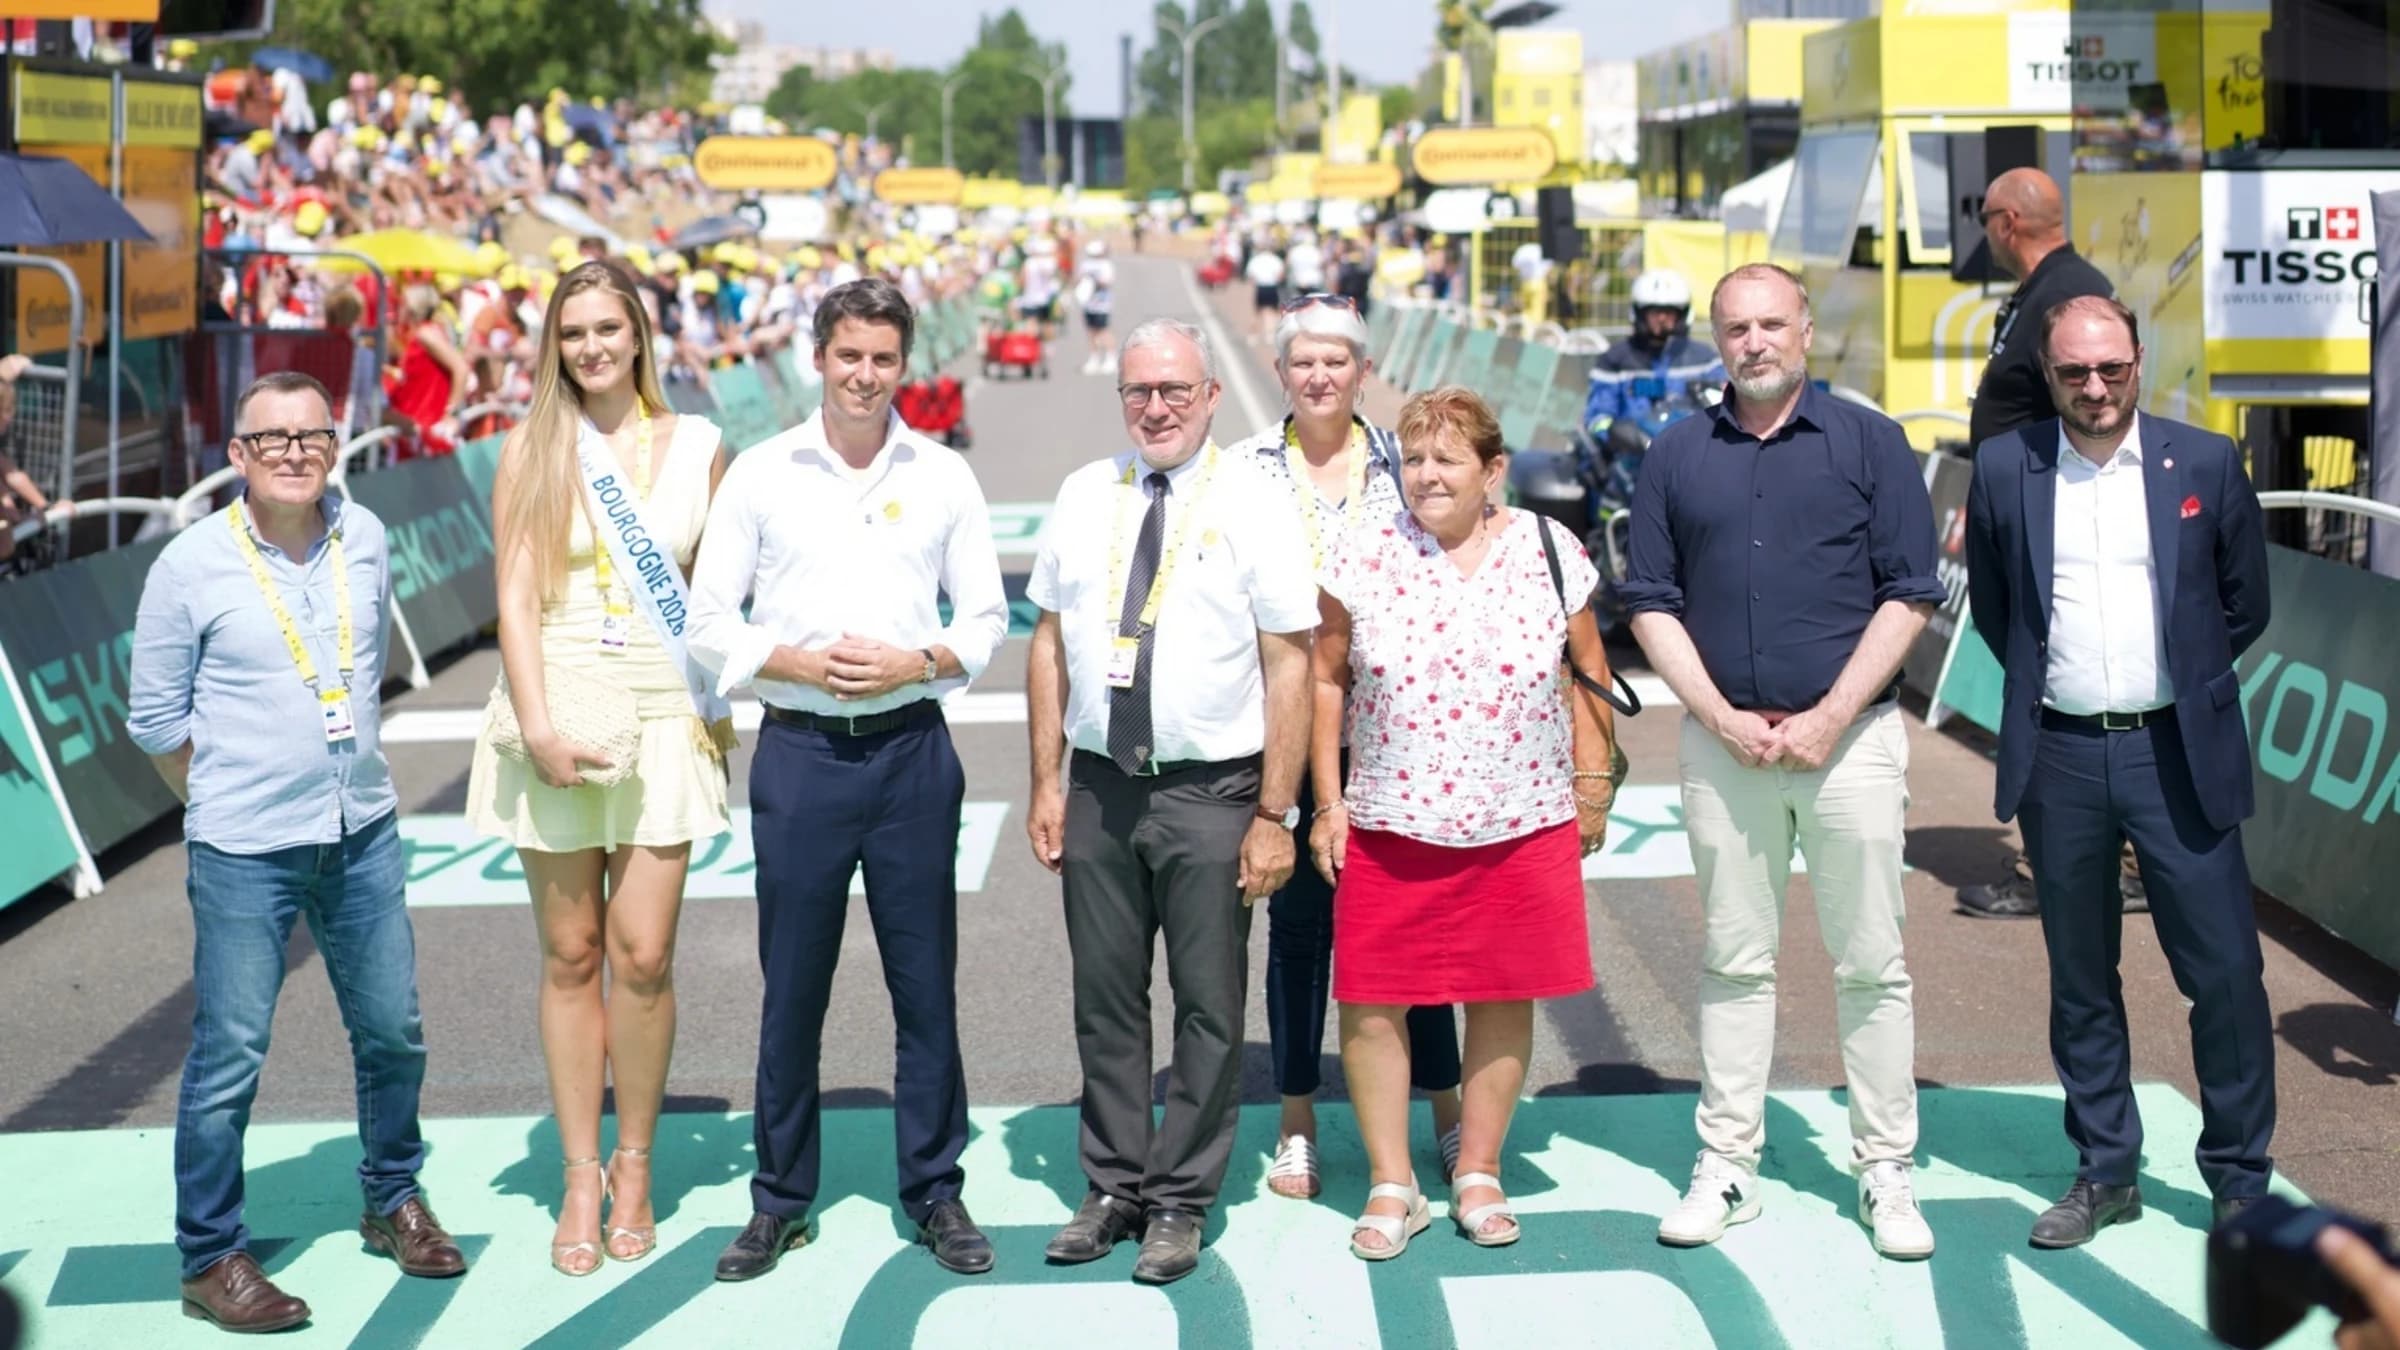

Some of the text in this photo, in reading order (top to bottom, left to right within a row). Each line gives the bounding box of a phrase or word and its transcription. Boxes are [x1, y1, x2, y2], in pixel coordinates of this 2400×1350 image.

[2027, 60, 2141, 82] TISSOT
[2224, 53, 2264, 80] TO
[2223, 251, 2377, 284] TISSO
[2223, 293, 2268, 304] SWISS
[592, 474, 687, 637] BOURGOGNE 2026
[29, 630, 135, 766] SK
